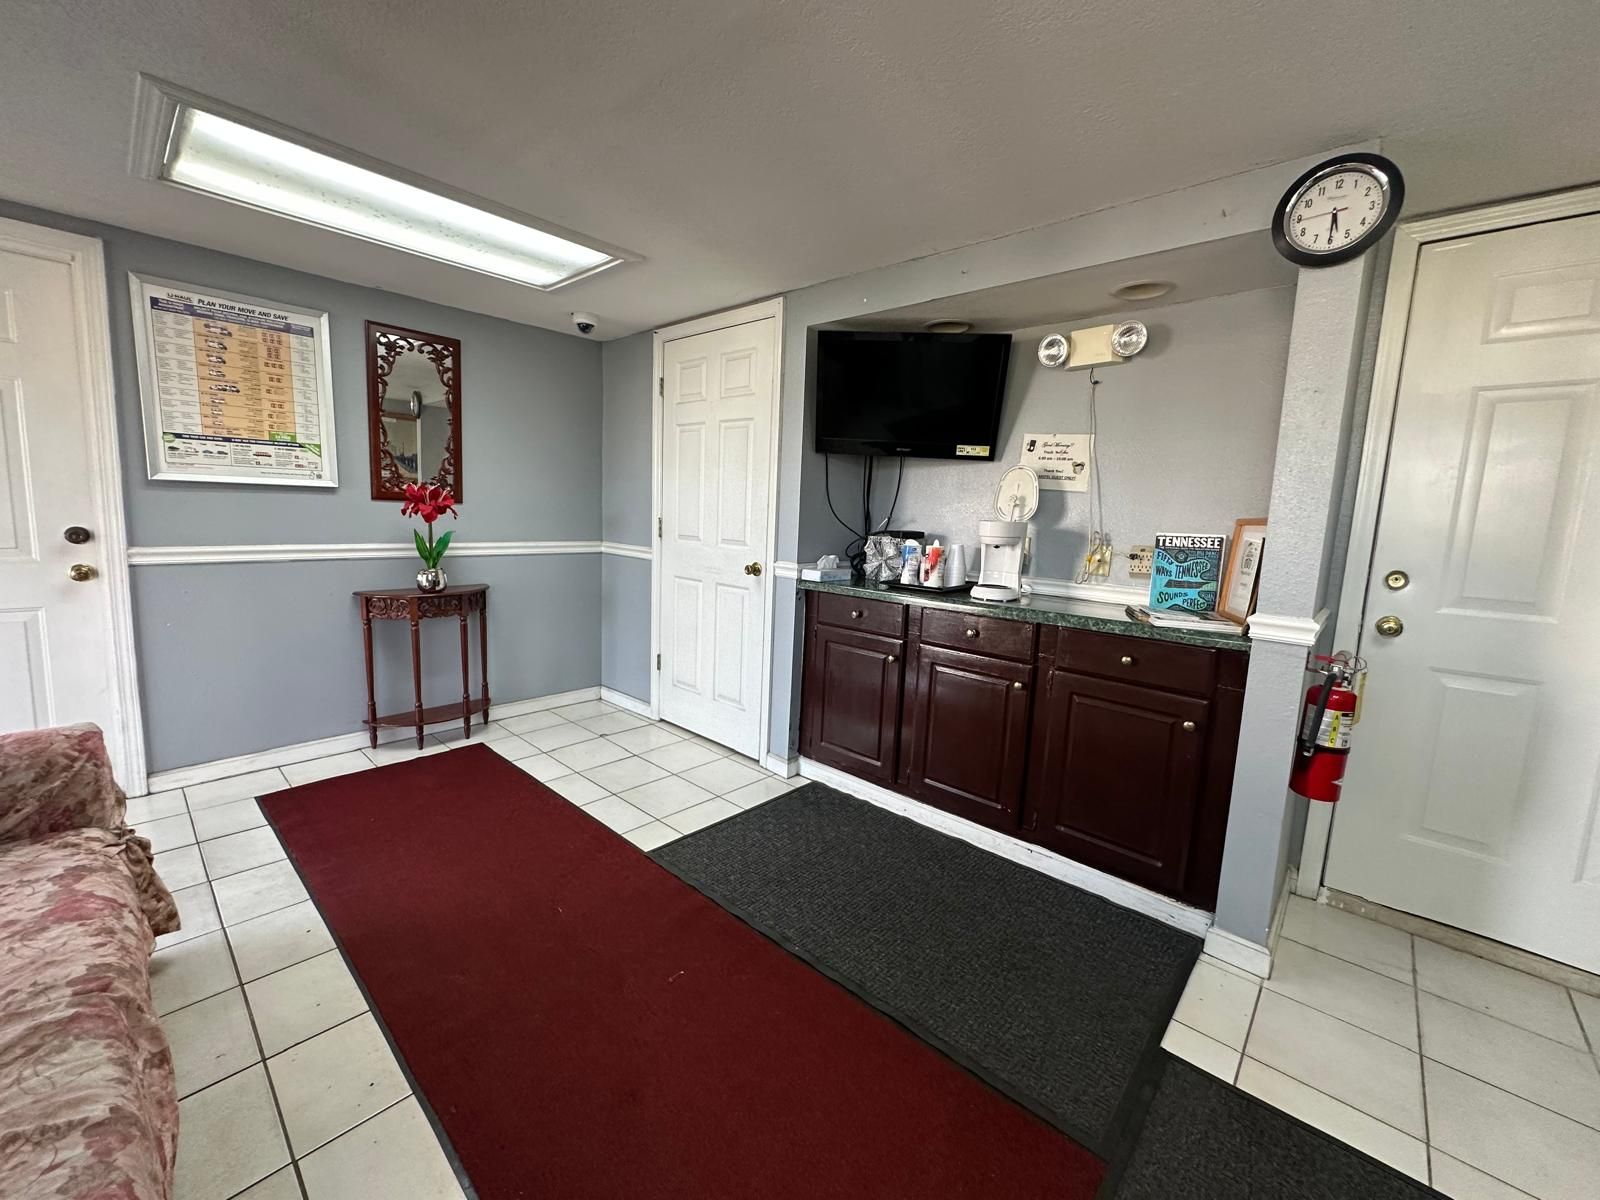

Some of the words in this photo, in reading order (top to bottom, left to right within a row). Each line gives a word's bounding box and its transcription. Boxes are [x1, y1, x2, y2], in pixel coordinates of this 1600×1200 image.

[1335, 178, 1344, 189] 12
[1354, 179, 1358, 189] 1
[1318, 186, 1326, 197] 11
[1364, 186, 1371, 197] 2
[1304, 198, 1313, 209] 10
[1369, 200, 1375, 211] 3
[1296, 214, 1302, 224] 9
[1359, 216, 1366, 227] 4
[1300, 227, 1306, 237] 8
[1344, 228, 1350, 239] 5
[1313, 233, 1319, 244] 7
[1327, 235, 1333, 245] 6
[197, 298, 216, 308] PLAN
[217, 302, 236, 312] YOUR
[237, 306, 256, 316] MOVE
[257, 311, 272, 319] AND
[272, 313, 289, 322] SAVE
[1157, 536, 1221, 549] TENNESSEE
[1156, 550, 1174, 566] FIFTY
[1155, 565, 1173, 578] WAYS
[1174, 560, 1209, 579] TENNESSEE
[1157, 591, 1189, 604] SOUNDS
